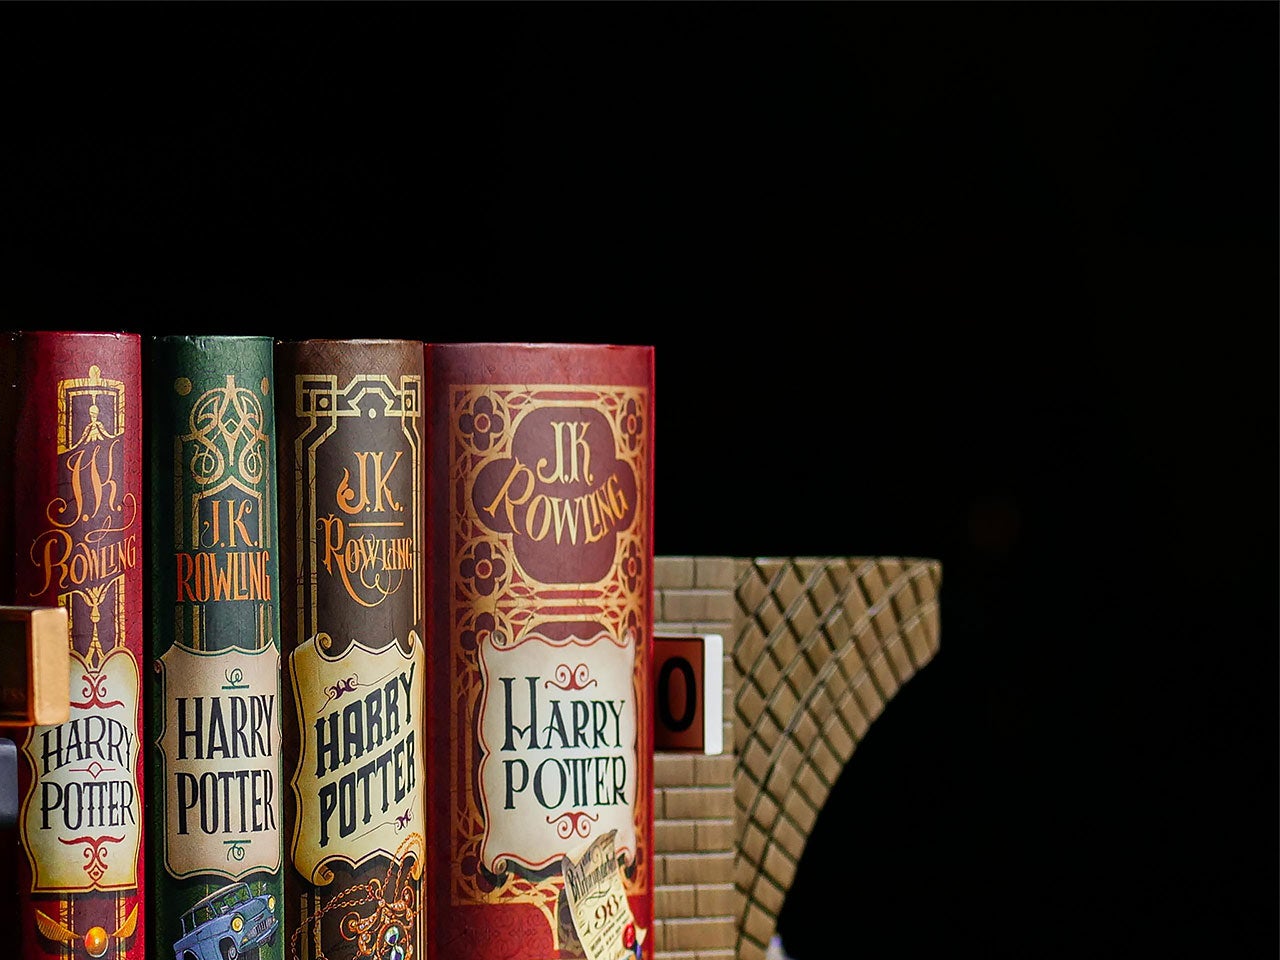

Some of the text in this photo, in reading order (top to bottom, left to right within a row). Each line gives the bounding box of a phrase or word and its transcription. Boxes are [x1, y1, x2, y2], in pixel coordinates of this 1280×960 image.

[47, 439, 122, 528] J.K.
[337, 451, 404, 514] J.K.
[536, 421, 595, 486] J.K.
[200, 498, 259, 548] J.K.
[482, 456, 629, 546] ROWLING
[30, 528, 136, 598] ROWLING
[175, 549, 272, 602] ROWLING
[316, 513, 414, 608] ROWLING
[40, 715, 134, 776] HARRY
[176, 694, 275, 761] HARRY
[313, 662, 416, 779] HARRY
[498, 676, 626, 751] HARRY
[40, 780, 136, 830] POTTER
[174, 768, 277, 835] POTTER
[318, 730, 416, 849] POTTER
[502, 755, 629, 810] POTTER
